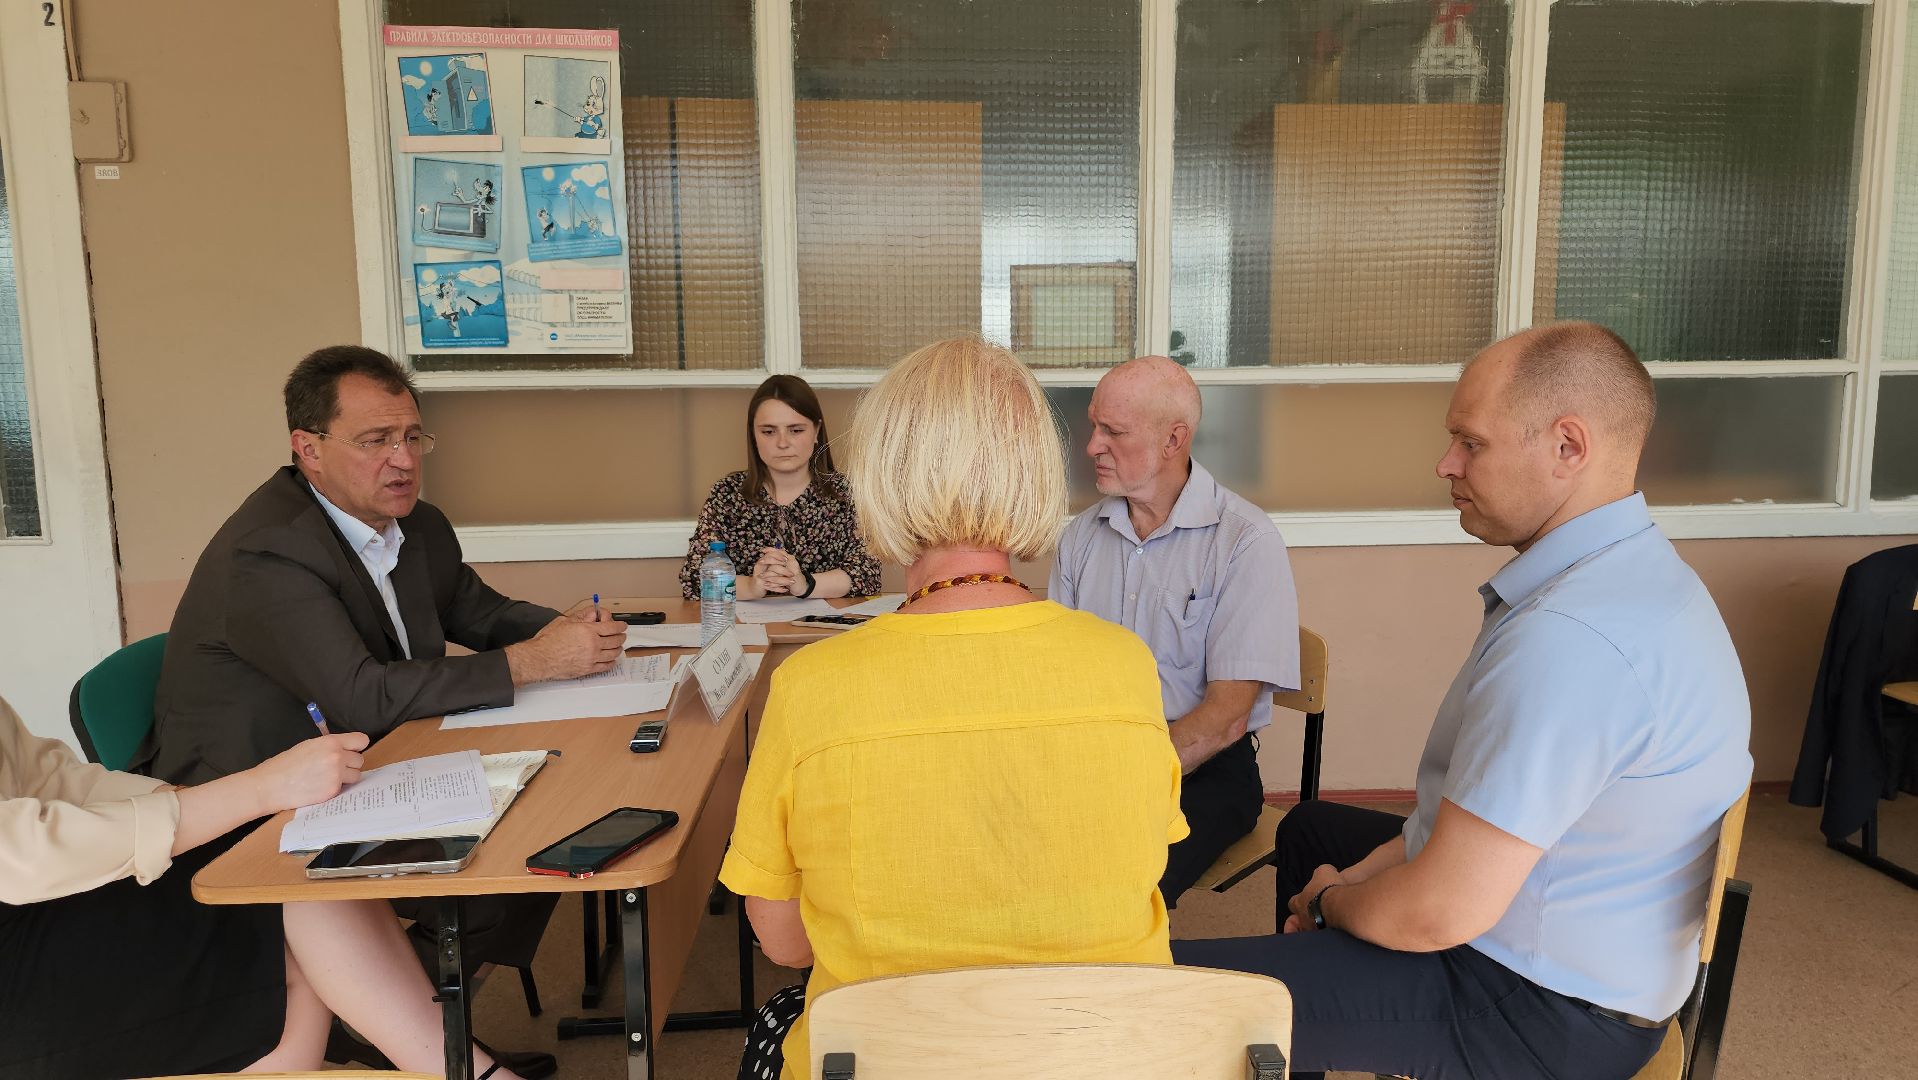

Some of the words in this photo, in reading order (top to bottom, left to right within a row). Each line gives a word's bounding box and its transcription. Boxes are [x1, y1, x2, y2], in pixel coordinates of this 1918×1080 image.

[41, 2, 56, 27] 2
[389, 30, 429, 43] ПРАВИЛА
[431, 31, 532, 45] ЭЛЕКТРОБЕЗОПАСНОСТИ
[535, 33, 552, 45] ДЛЯ
[555, 33, 613, 47] ШКОЛЬНИКОВ
